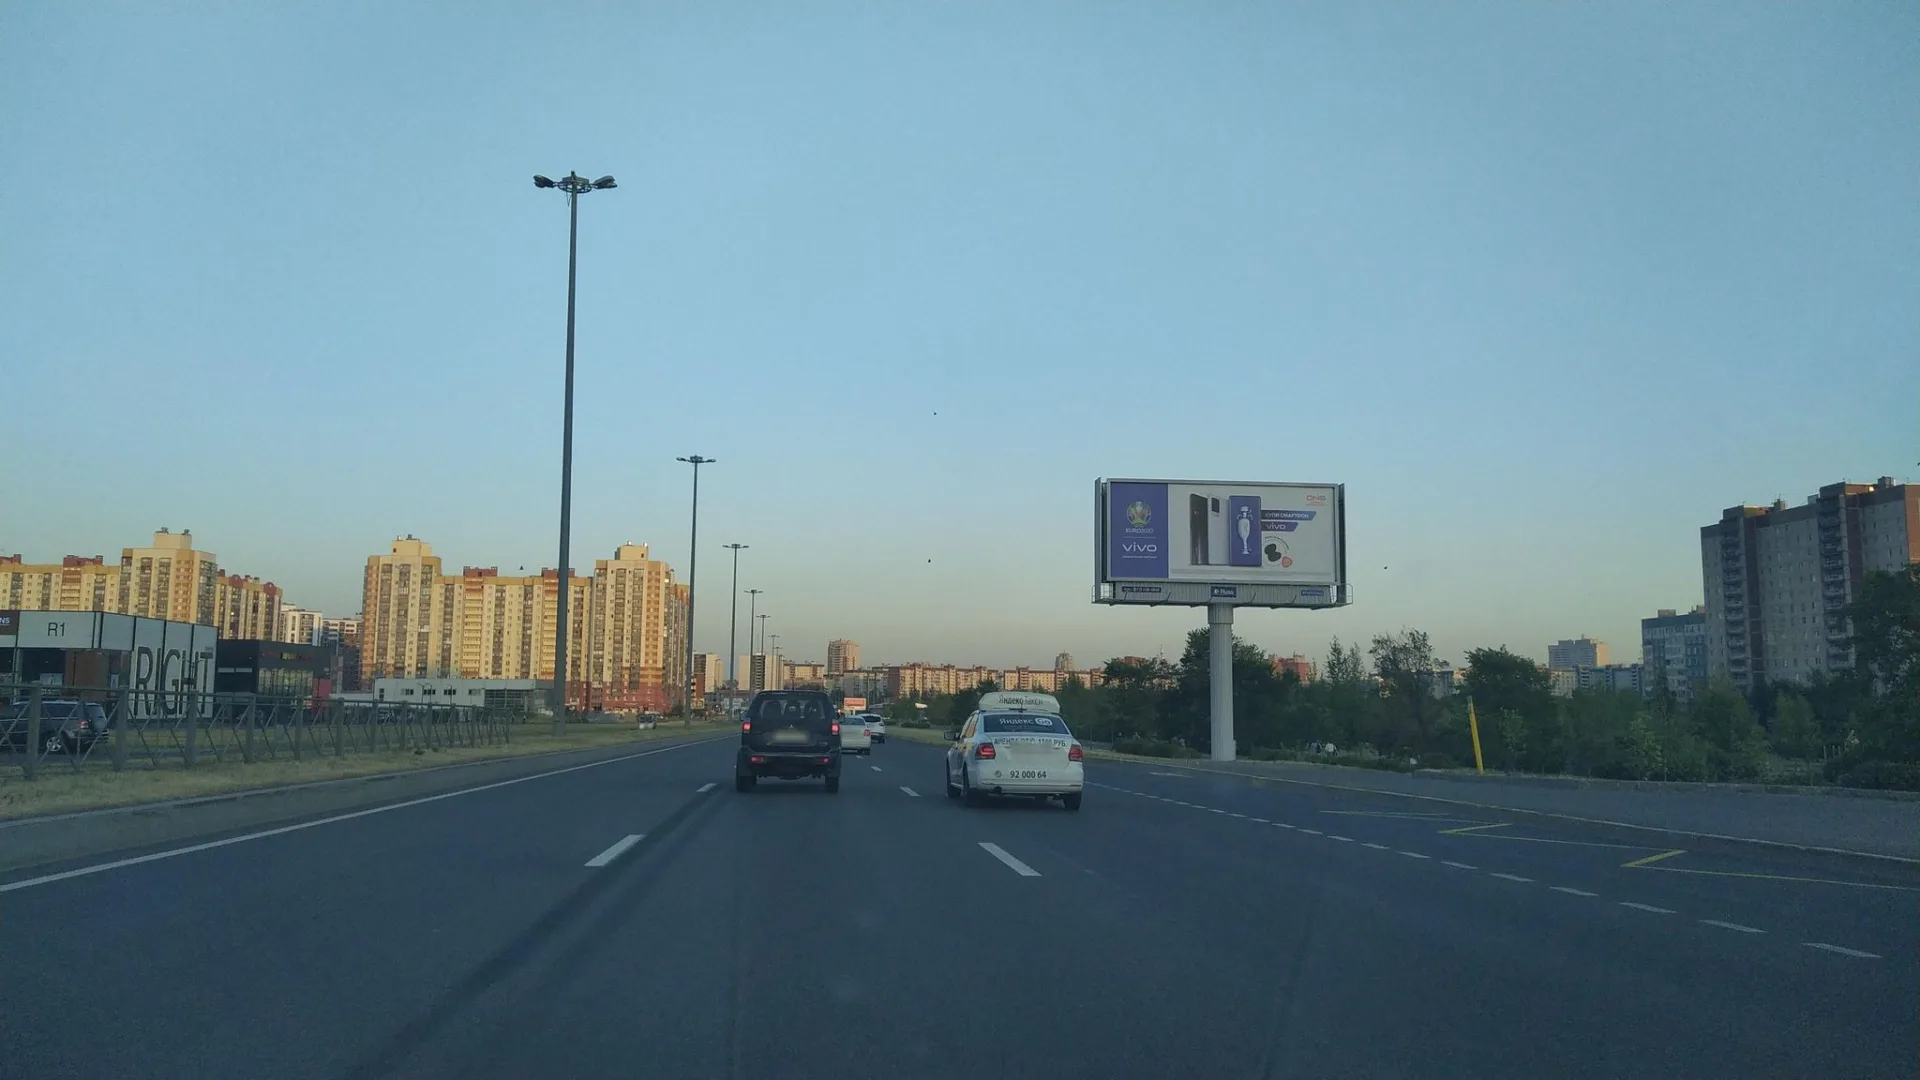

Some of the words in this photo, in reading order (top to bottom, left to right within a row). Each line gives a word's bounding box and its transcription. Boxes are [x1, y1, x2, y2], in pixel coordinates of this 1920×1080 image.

[1122, 542, 1157, 552] vivo
[48, 622, 65, 637] R1
[135, 646, 214, 717] RIGHT
[1010, 771, 1019, 779] 92
[1021, 771, 1035, 779] 000
